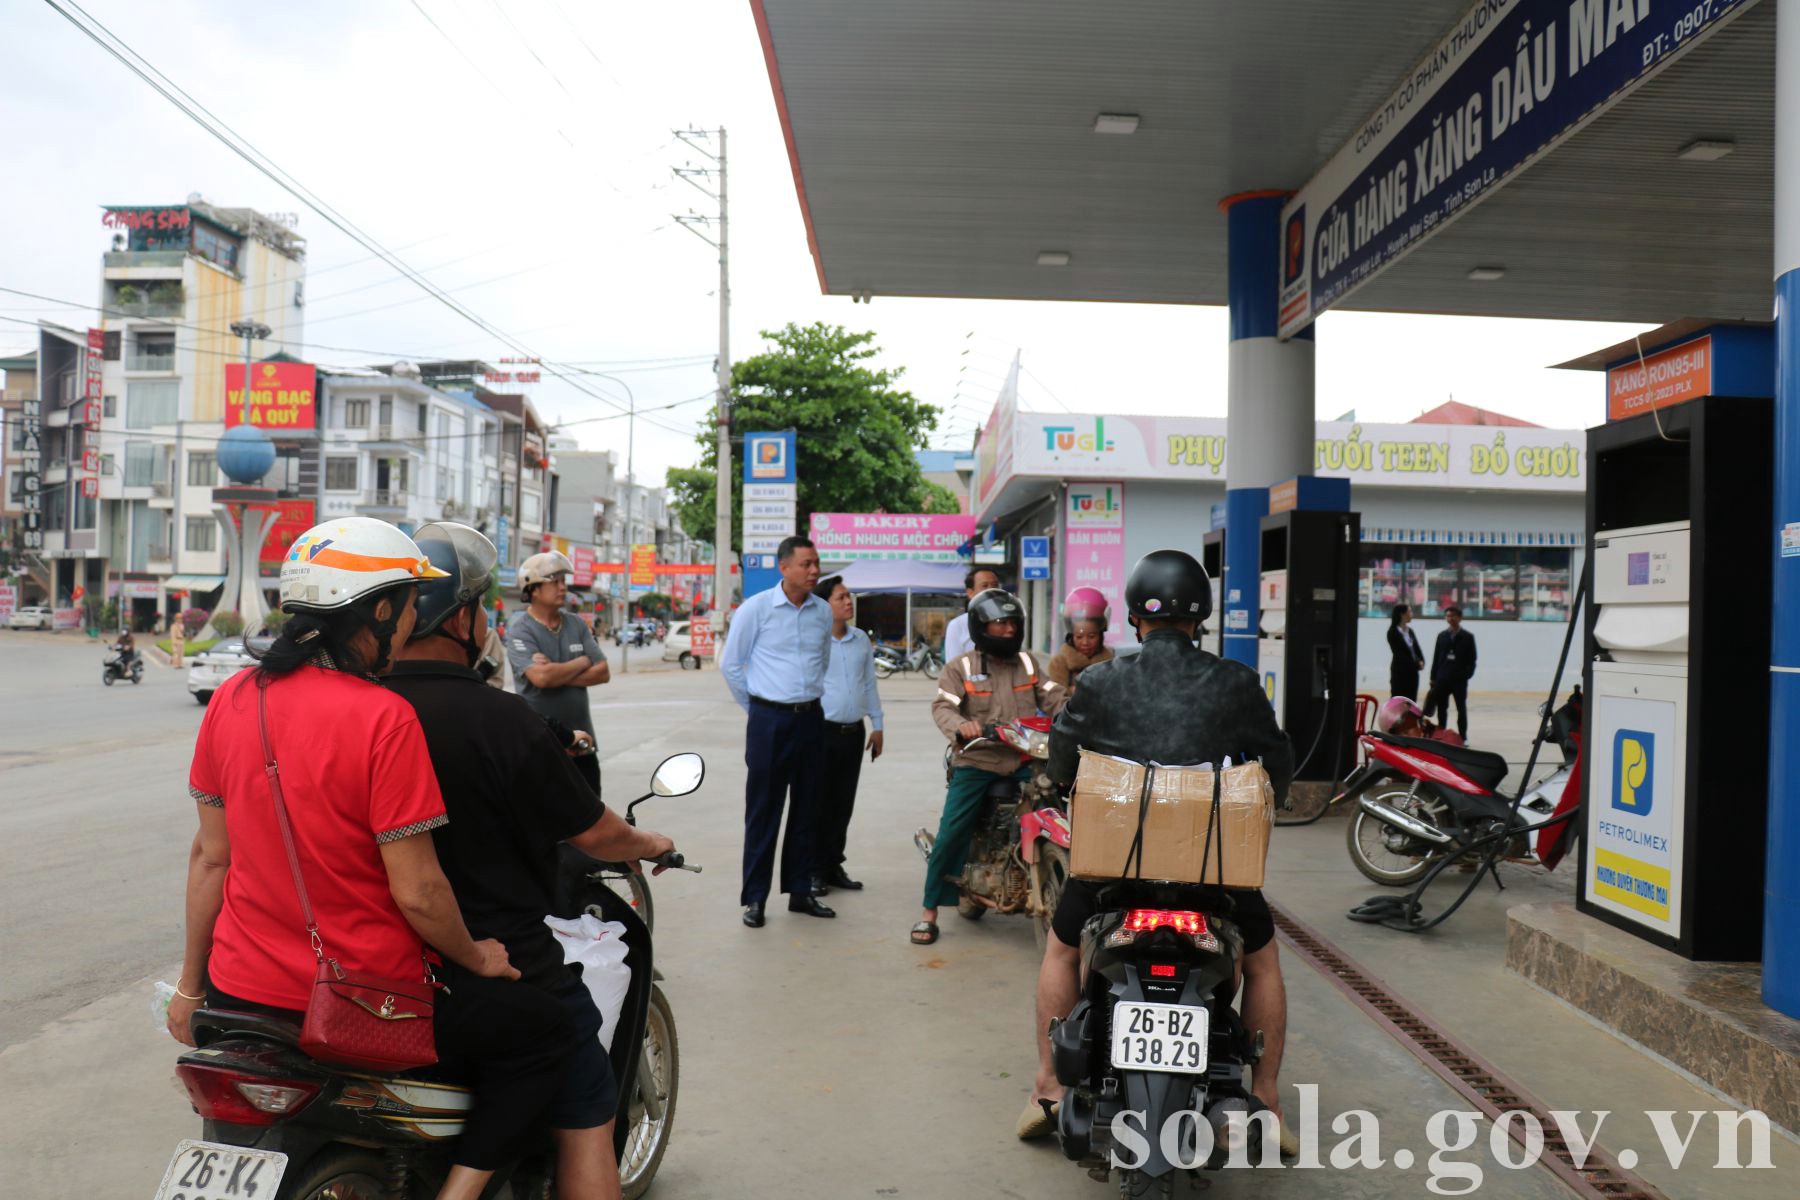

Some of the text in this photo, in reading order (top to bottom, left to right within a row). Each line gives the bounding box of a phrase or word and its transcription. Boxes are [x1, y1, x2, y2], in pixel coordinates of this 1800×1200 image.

[1673, 0, 1722, 42] 0907.
[1384, 103, 1397, 125] TY
[1317, 204, 1350, 279] CỬA
[1354, 160, 1408, 250] HÀNG
[1413, 92, 1483, 204] XĂNG
[1492, 19, 1556, 141] DẦU
[1483, 167, 1495, 183] La
[1648, 348, 1705, 385] RON95-III
[1167, 434, 1226, 475] PHỤ
[1379, 442, 1449, 472] TEEN
[1470, 431, 1580, 477] ĐỒ CHƠI
[816, 529, 852, 546] HỒNG
[856, 533, 899, 546] NHUNG
[903, 531, 931, 548] MỘC
[853, 516, 933, 529] BAKERY
[1599, 820, 1668, 853] PETROLIMEX
[1128, 1007, 1194, 1038] 26-B2
[1121, 1036, 1201, 1068] 138.29
